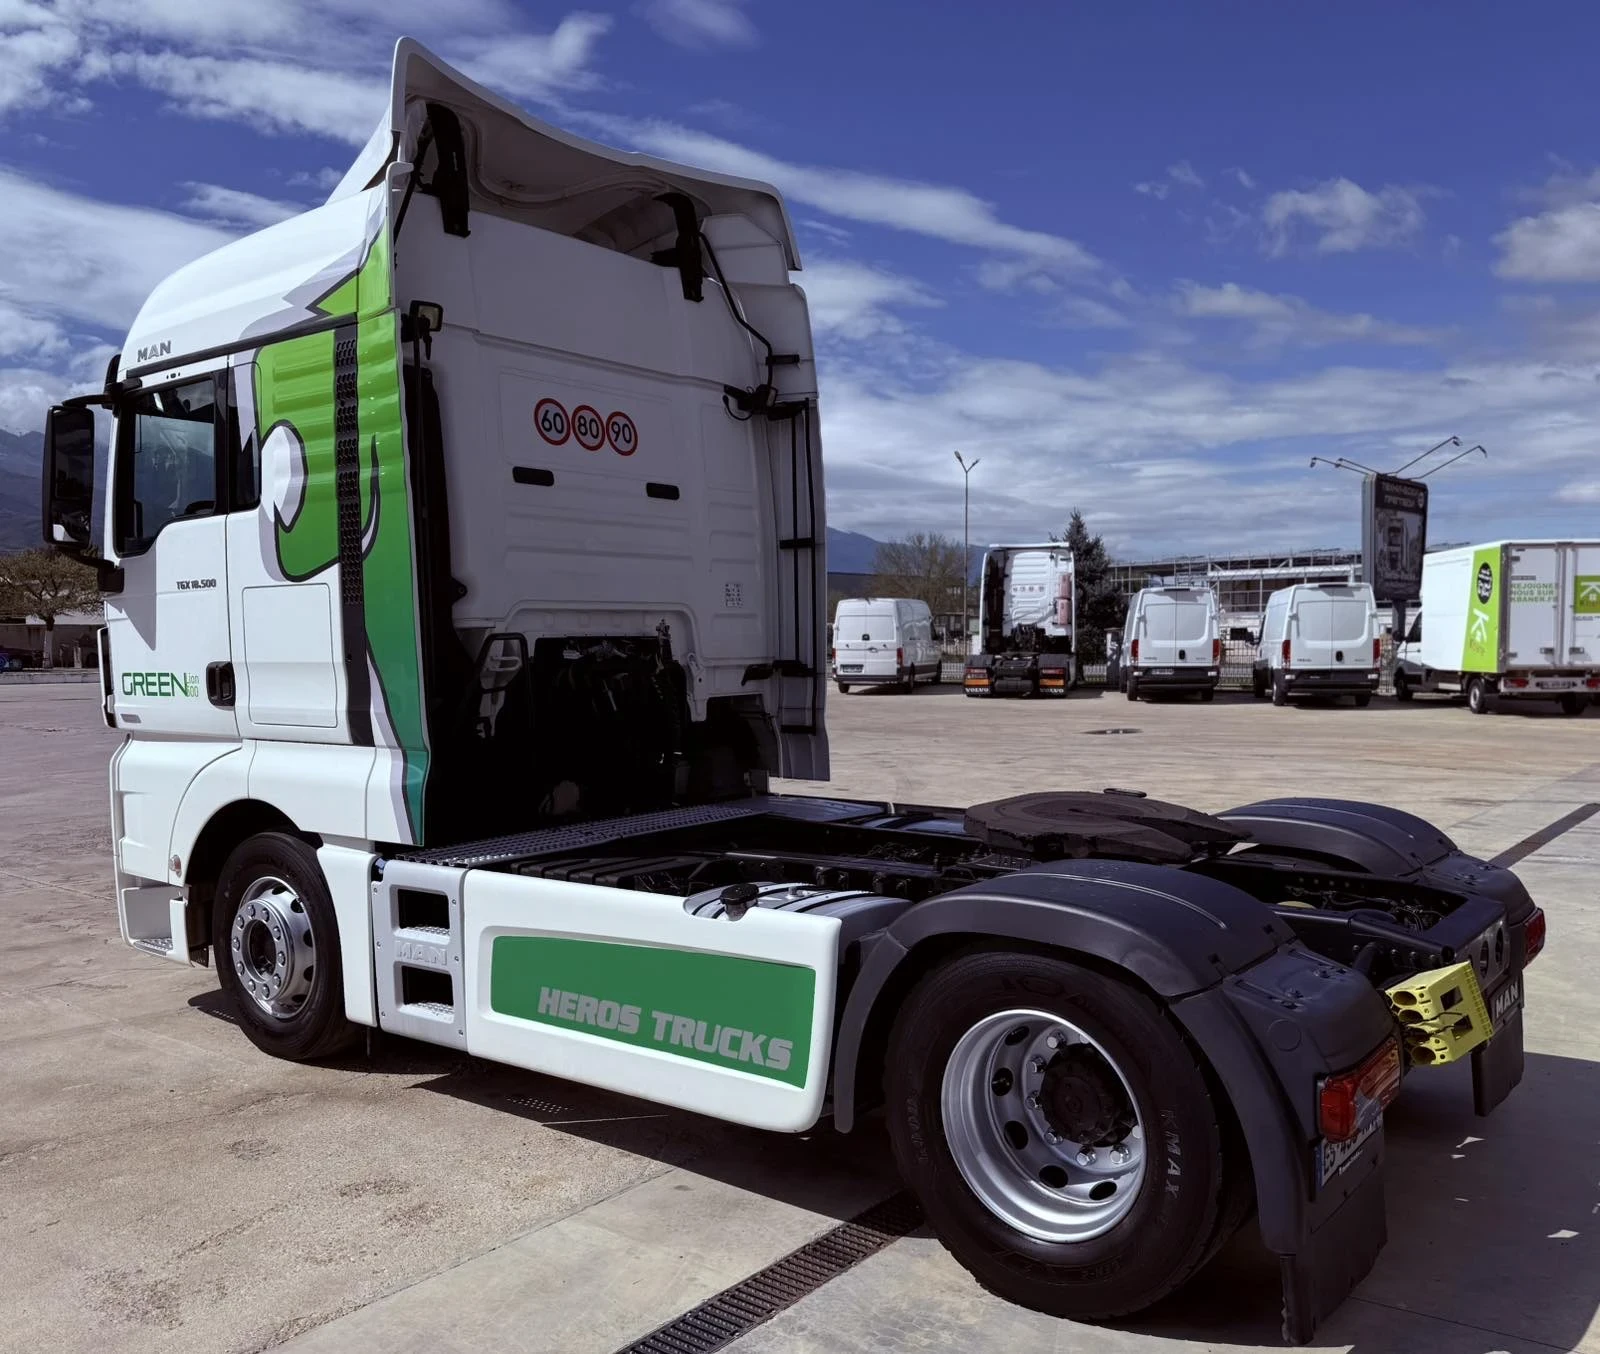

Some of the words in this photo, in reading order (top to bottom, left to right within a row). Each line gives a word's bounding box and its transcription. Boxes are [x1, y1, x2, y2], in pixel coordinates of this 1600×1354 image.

[137, 341, 171, 362] MAN
[541, 410, 564, 434] 60
[577, 415, 600, 439] 80
[611, 421, 632, 444] 90
[176, 580, 190, 590] TGX
[122, 672, 187, 697] GREEN
[395, 940, 448, 966] MAN
[1496, 981, 1519, 1019] MAN
[537, 986, 642, 1035] HEROS
[651, 1010, 794, 1072] TRUCKS
